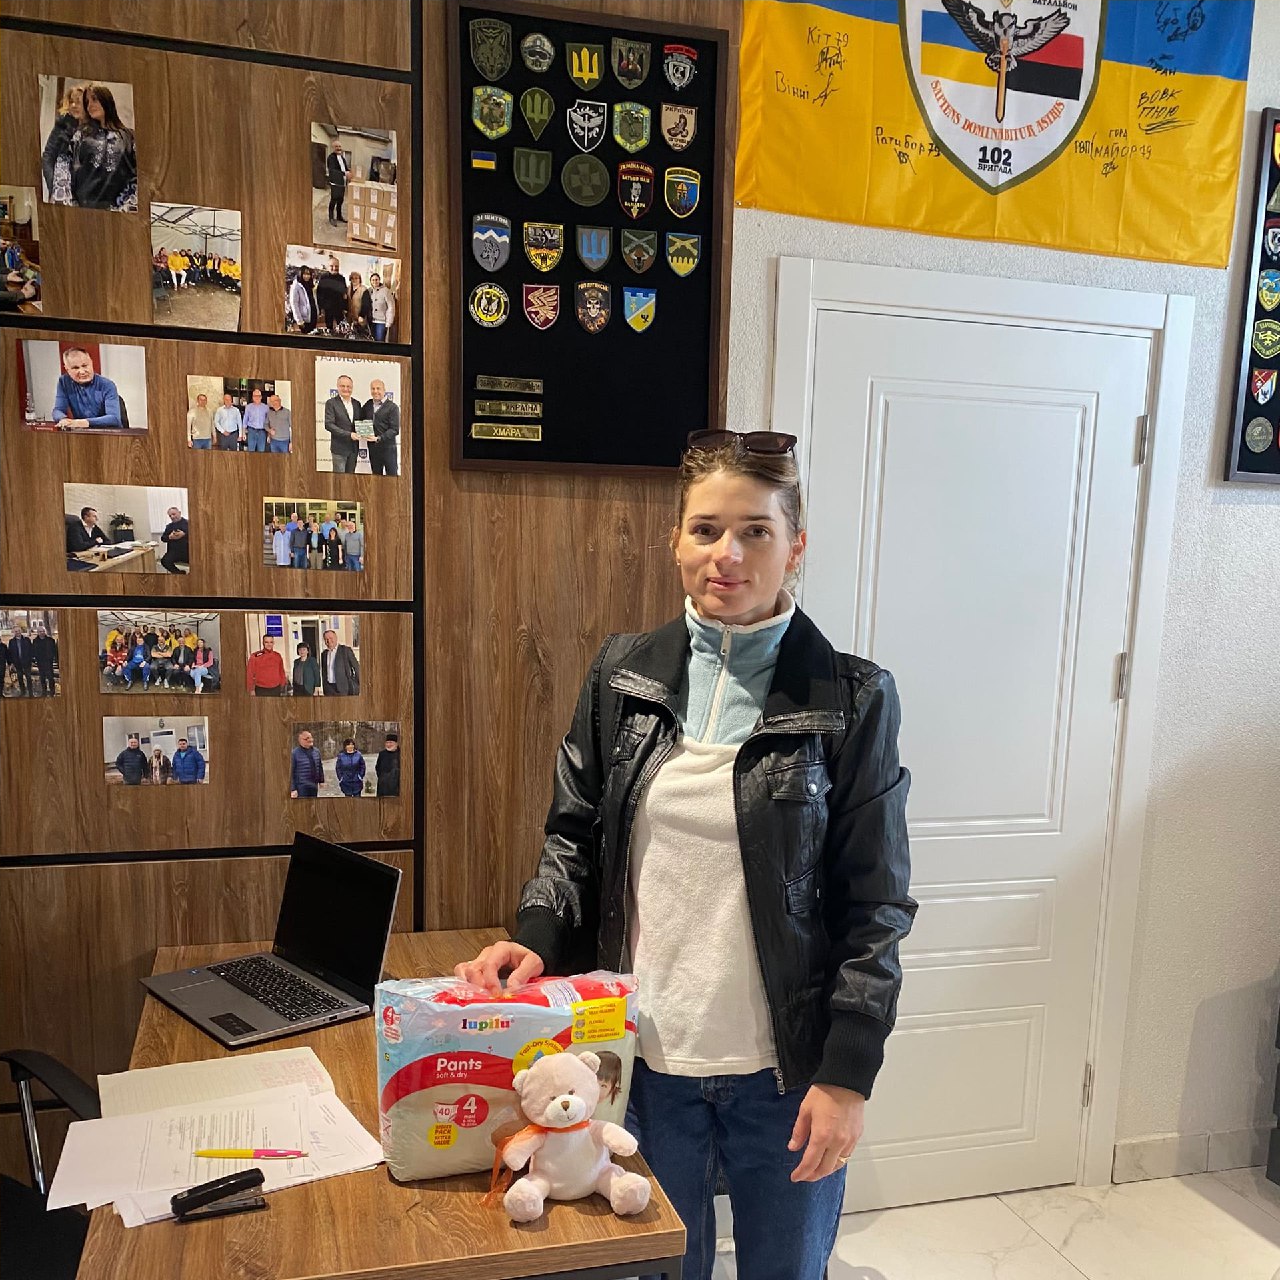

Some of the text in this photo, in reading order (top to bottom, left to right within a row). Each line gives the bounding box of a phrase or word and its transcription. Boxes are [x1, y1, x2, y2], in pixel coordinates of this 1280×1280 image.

[931, 79, 962, 125] SAPIENS
[978, 145, 1013, 167] 102
[977, 163, 1013, 175] БРИГАДА
[492, 427, 522, 437] ХМАРА
[461, 1018, 510, 1031] lupilu
[436, 1058, 482, 1072] Pants
[457, 1071, 468, 1079] dry
[463, 1096, 478, 1114] 4
